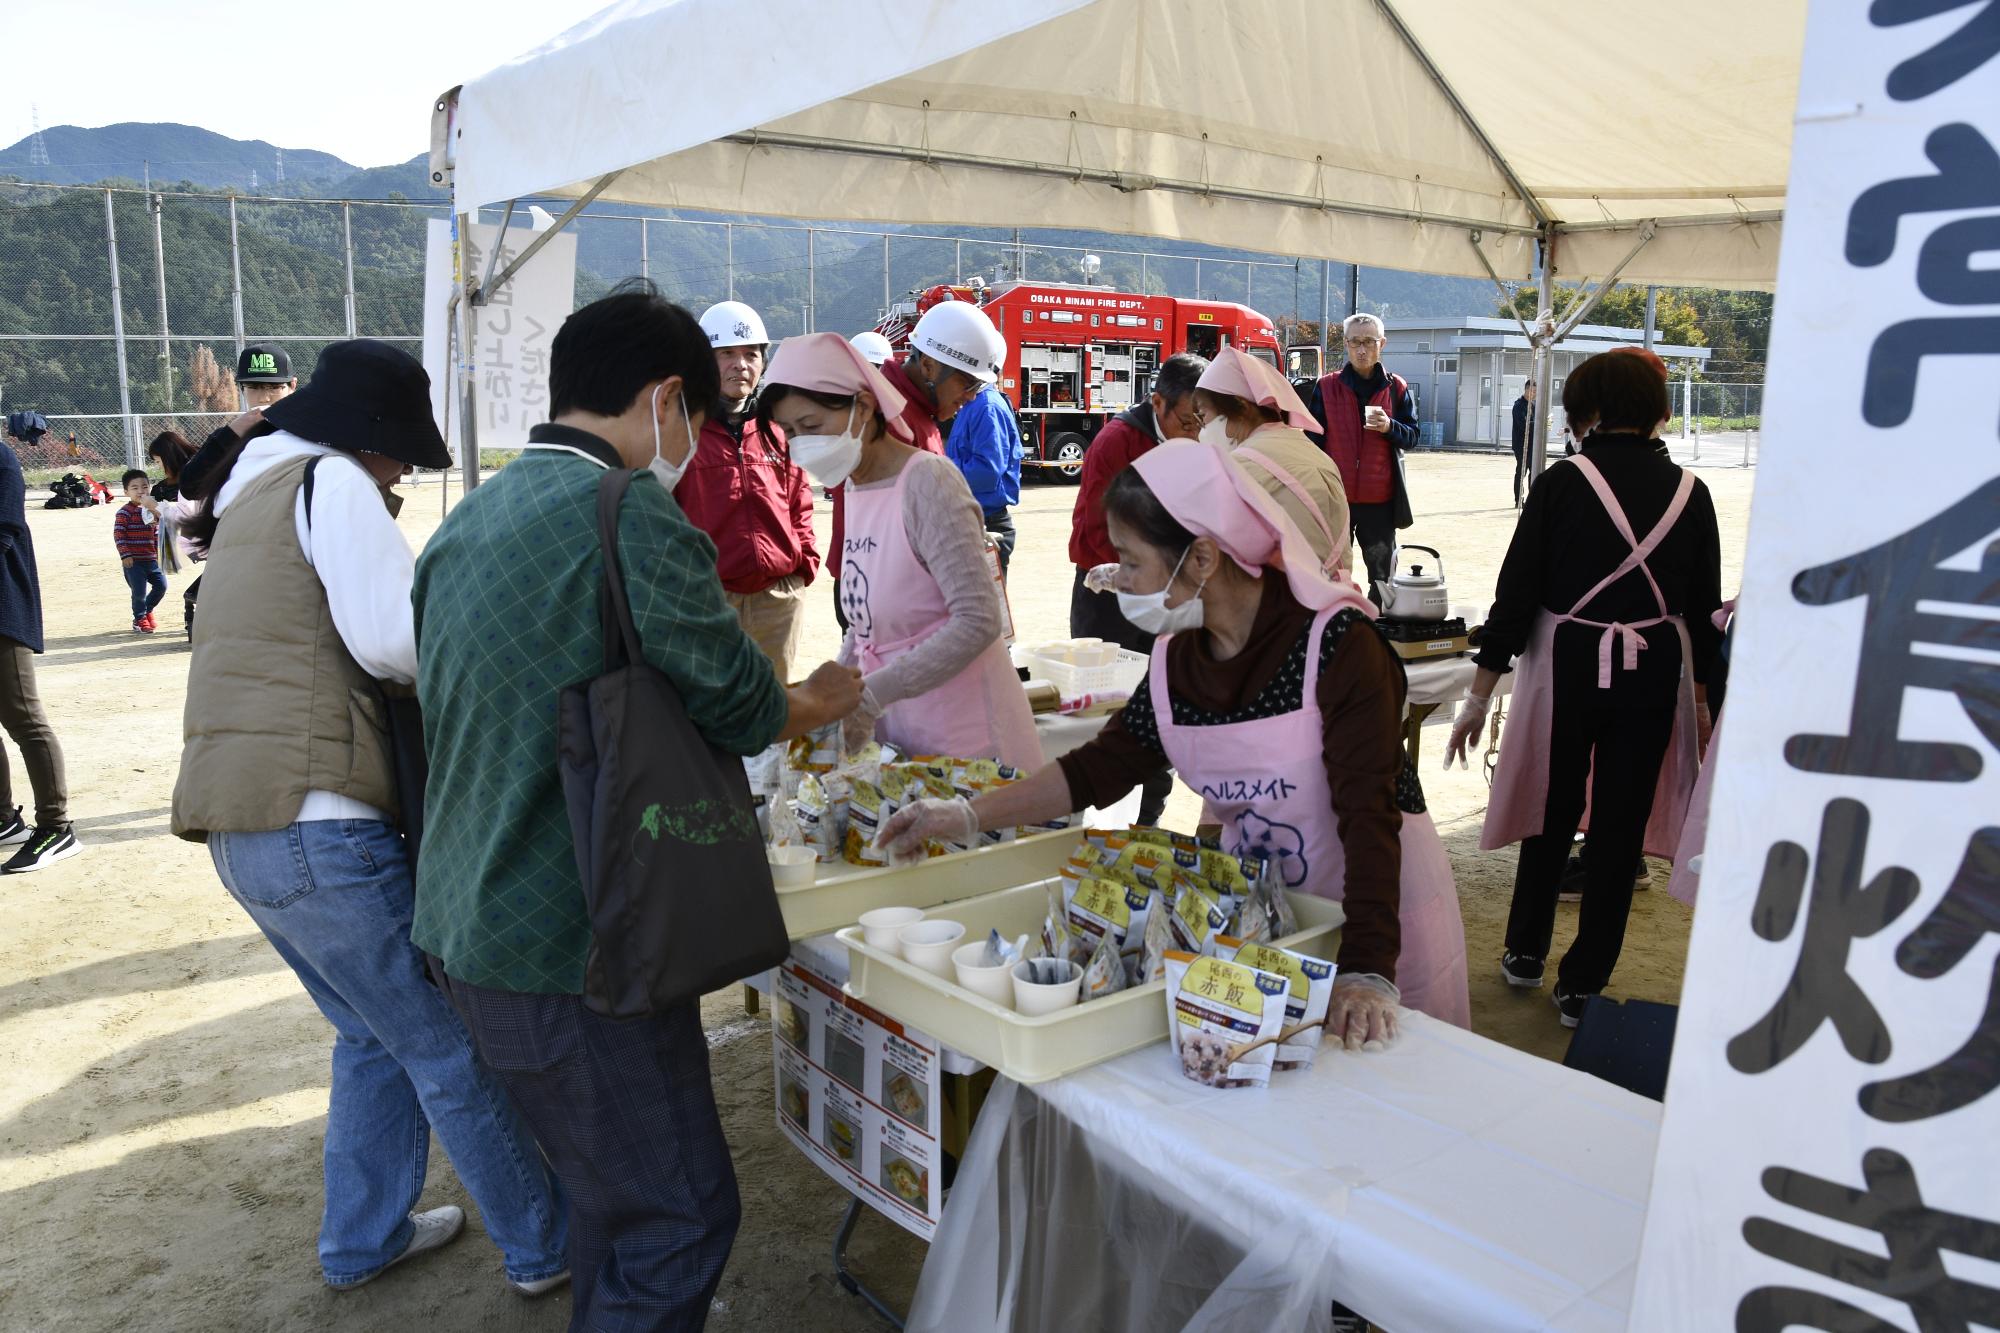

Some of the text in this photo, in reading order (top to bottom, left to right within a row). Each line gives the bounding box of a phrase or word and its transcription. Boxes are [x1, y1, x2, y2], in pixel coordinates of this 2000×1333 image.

[1030, 294, 1145, 310] OSAKA MINAMI FIRE DEPT.
[250, 353, 275, 368] MB
[1202, 777, 1297, 801] ヘルスメイト
[1087, 893, 1118, 918] 赤飯
[1256, 946, 1289, 966] 尾西の
[1209, 961, 1242, 981] 尾西の
[1199, 976, 1246, 1006] 赤飯
[1258, 977, 1282, 992] 不使用
